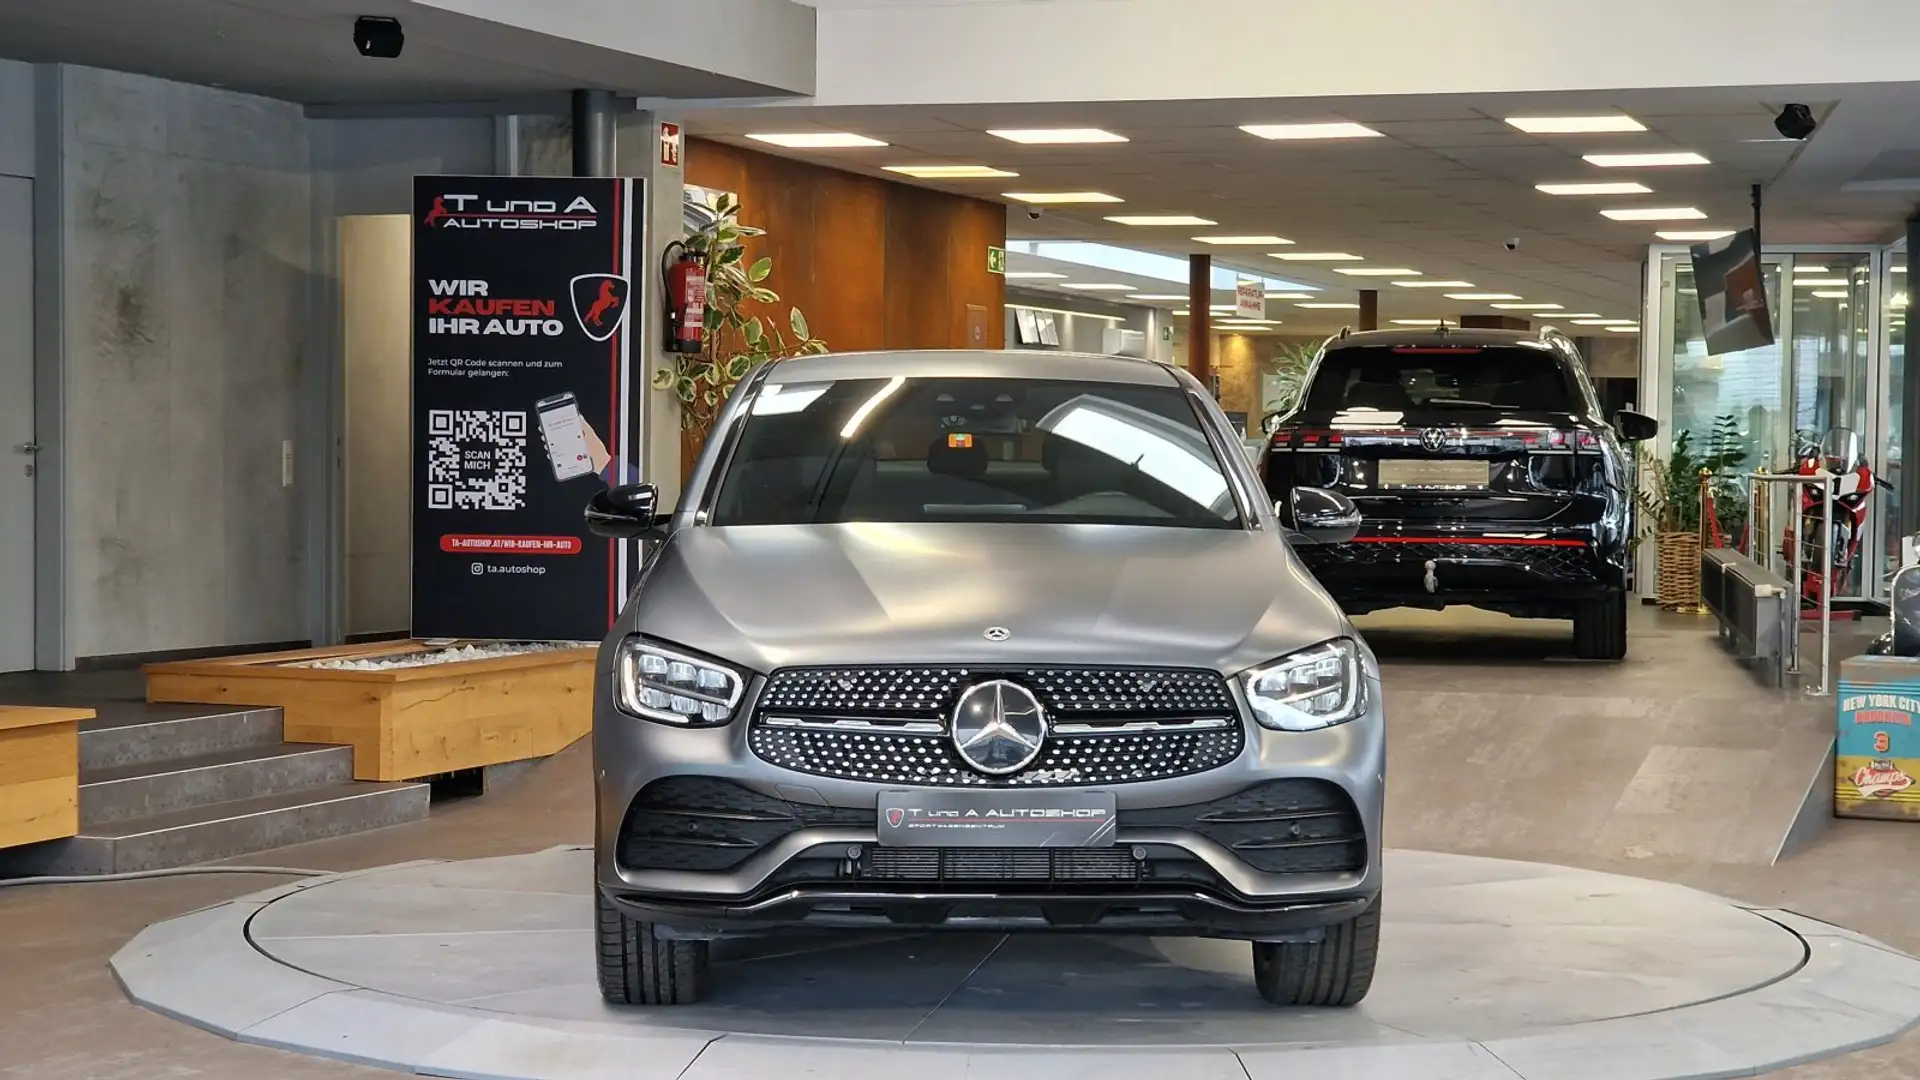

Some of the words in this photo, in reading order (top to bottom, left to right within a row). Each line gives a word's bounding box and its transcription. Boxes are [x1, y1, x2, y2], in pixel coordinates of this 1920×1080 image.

[443, 194, 478, 211] T
[563, 195, 597, 213] A
[442, 218, 598, 230] AUTOSHOP
[428, 279, 489, 297] WIR
[428, 299, 555, 317] KAUFEN
[429, 318, 480, 335] IHR
[482, 319, 564, 336] AUTO
[427, 358, 449, 366] Jetzt
[449, 358, 464, 368] QR
[464, 358, 487, 367] Code
[488, 360, 524, 368] scannen
[525, 360, 543, 368] und
[427, 368, 466, 376] Formular
[467, 368, 510, 378] gelangen:
[464, 451, 491, 460] SCAN
[464, 461, 491, 470] MICH
[487, 564, 546, 575] ta.autoshop
[1843, 695, 1867, 712] NEW
[1868, 694, 1898, 708] YORK
[1874, 731, 1890, 752] 3
[1854, 767, 1906, 786] Champs
[908, 808, 923, 817] T
[965, 808, 979, 817] A
[985, 808, 1107, 818] AUTOSHOP
